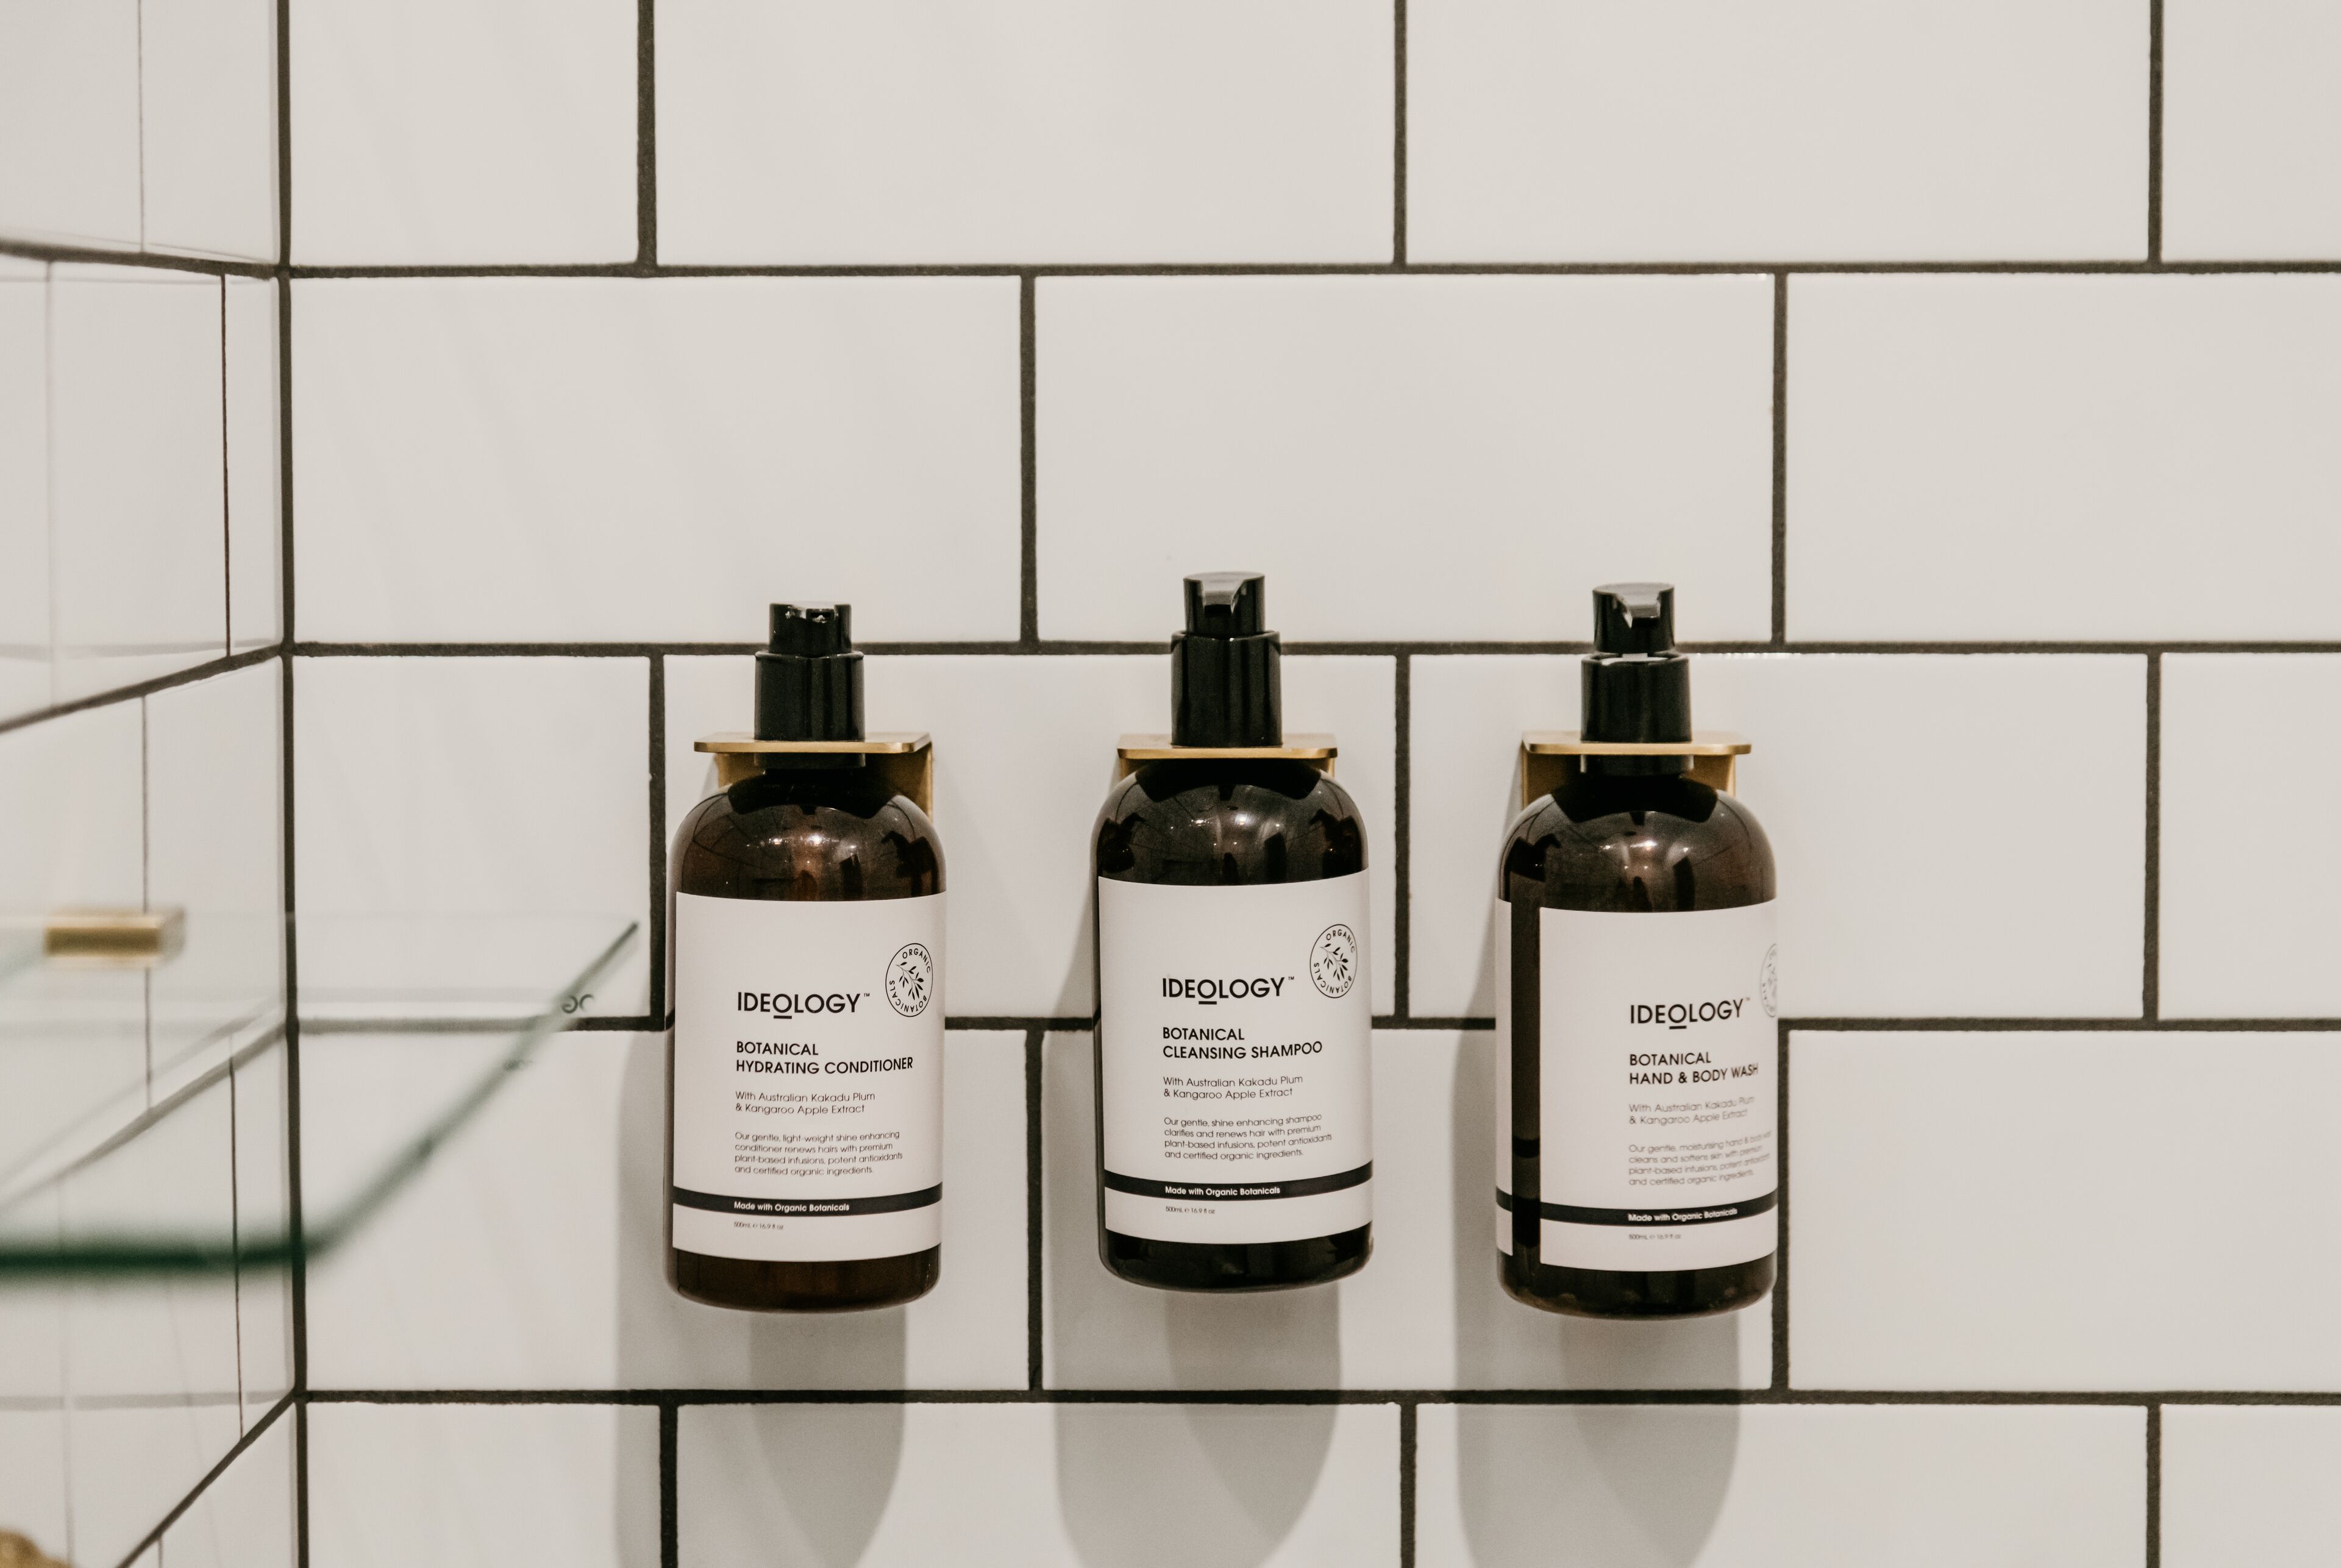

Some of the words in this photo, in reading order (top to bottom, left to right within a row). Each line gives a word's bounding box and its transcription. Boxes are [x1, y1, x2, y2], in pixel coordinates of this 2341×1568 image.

[1326, 929, 1355, 953] ORGANIC
[902, 948, 932, 973] ORGANIC
[1314, 962, 1352, 994] BOTANICALS
[889, 980, 927, 1012] BOTANICALS
[1163, 977, 1285, 1005] IDEOLOGY
[738, 992, 860, 1019] IDEOLOGY
[1631, 999, 1743, 1030] IDEOLOGY
[1163, 1027, 1244, 1041] BOTANICAL
[737, 1041, 818, 1055] BOTANICAL
[1163, 1046, 1246, 1059] CLEANSING
[1252, 1041, 1322, 1058] SHAMPOO
[736, 1060, 819, 1074] HYDRATING
[825, 1057, 913, 1074] CONDITIONER
[1630, 1052, 1711, 1066] BOTANICAL
[1630, 1072, 1673, 1084] HAND
[1678, 1072, 1687, 1083] &
[1693, 1069, 1727, 1083] BODY
[1731, 1064, 1758, 1078] WASH
[1163, 1077, 1183, 1086] With
[1239, 1078, 1277, 1086] Kakadu
[736, 1091, 755, 1100] With
[759, 1092, 807, 1102] Australian
[1174, 1089, 1222, 1100] Kangaroo
[1225, 1091, 1256, 1100] Apple
[1260, 1088, 1292, 1097] Extract
[746, 1104, 794, 1115] Kangaroo
[797, 1106, 828, 1115] Apple
[832, 1105, 864, 1113] Extract
[1655, 1103, 1702, 1112] Australian
[1236, 1118, 1283, 1127] enhancing
[1286, 1114, 1322, 1127] shampoo
[1630, 1116, 1636, 1124] &
[1641, 1116, 1690, 1126] Kangaroo
[1693, 1114, 1720, 1123] Apple
[1164, 1128, 1194, 1137] clarifies
[1288, 1125, 1320, 1136] premium
[783, 1135, 833, 1144] light-weight
[1165, 1140, 1214, 1149] plant-based
[1258, 1139, 1286, 1149] potent
[1288, 1134, 1332, 1146] antioxidants
[860, 1144, 893, 1153] premium
[1220, 1152, 1253, 1161] organic
[1256, 1149, 1304, 1160] ingredients.
[735, 1155, 785, 1164] plant-based
[828, 1156, 856, 1165] potent
[859, 1152, 902, 1162] antioxidants
[791, 1168, 824, 1177] organic
[1206, 1188, 1238, 1197] Organic
[734, 1201, 755, 1210] Made
[775, 1204, 807, 1213] Organic
[1672, 1213, 1703, 1222] Organic
[1704, 1208, 1737, 1218] Botanicals
